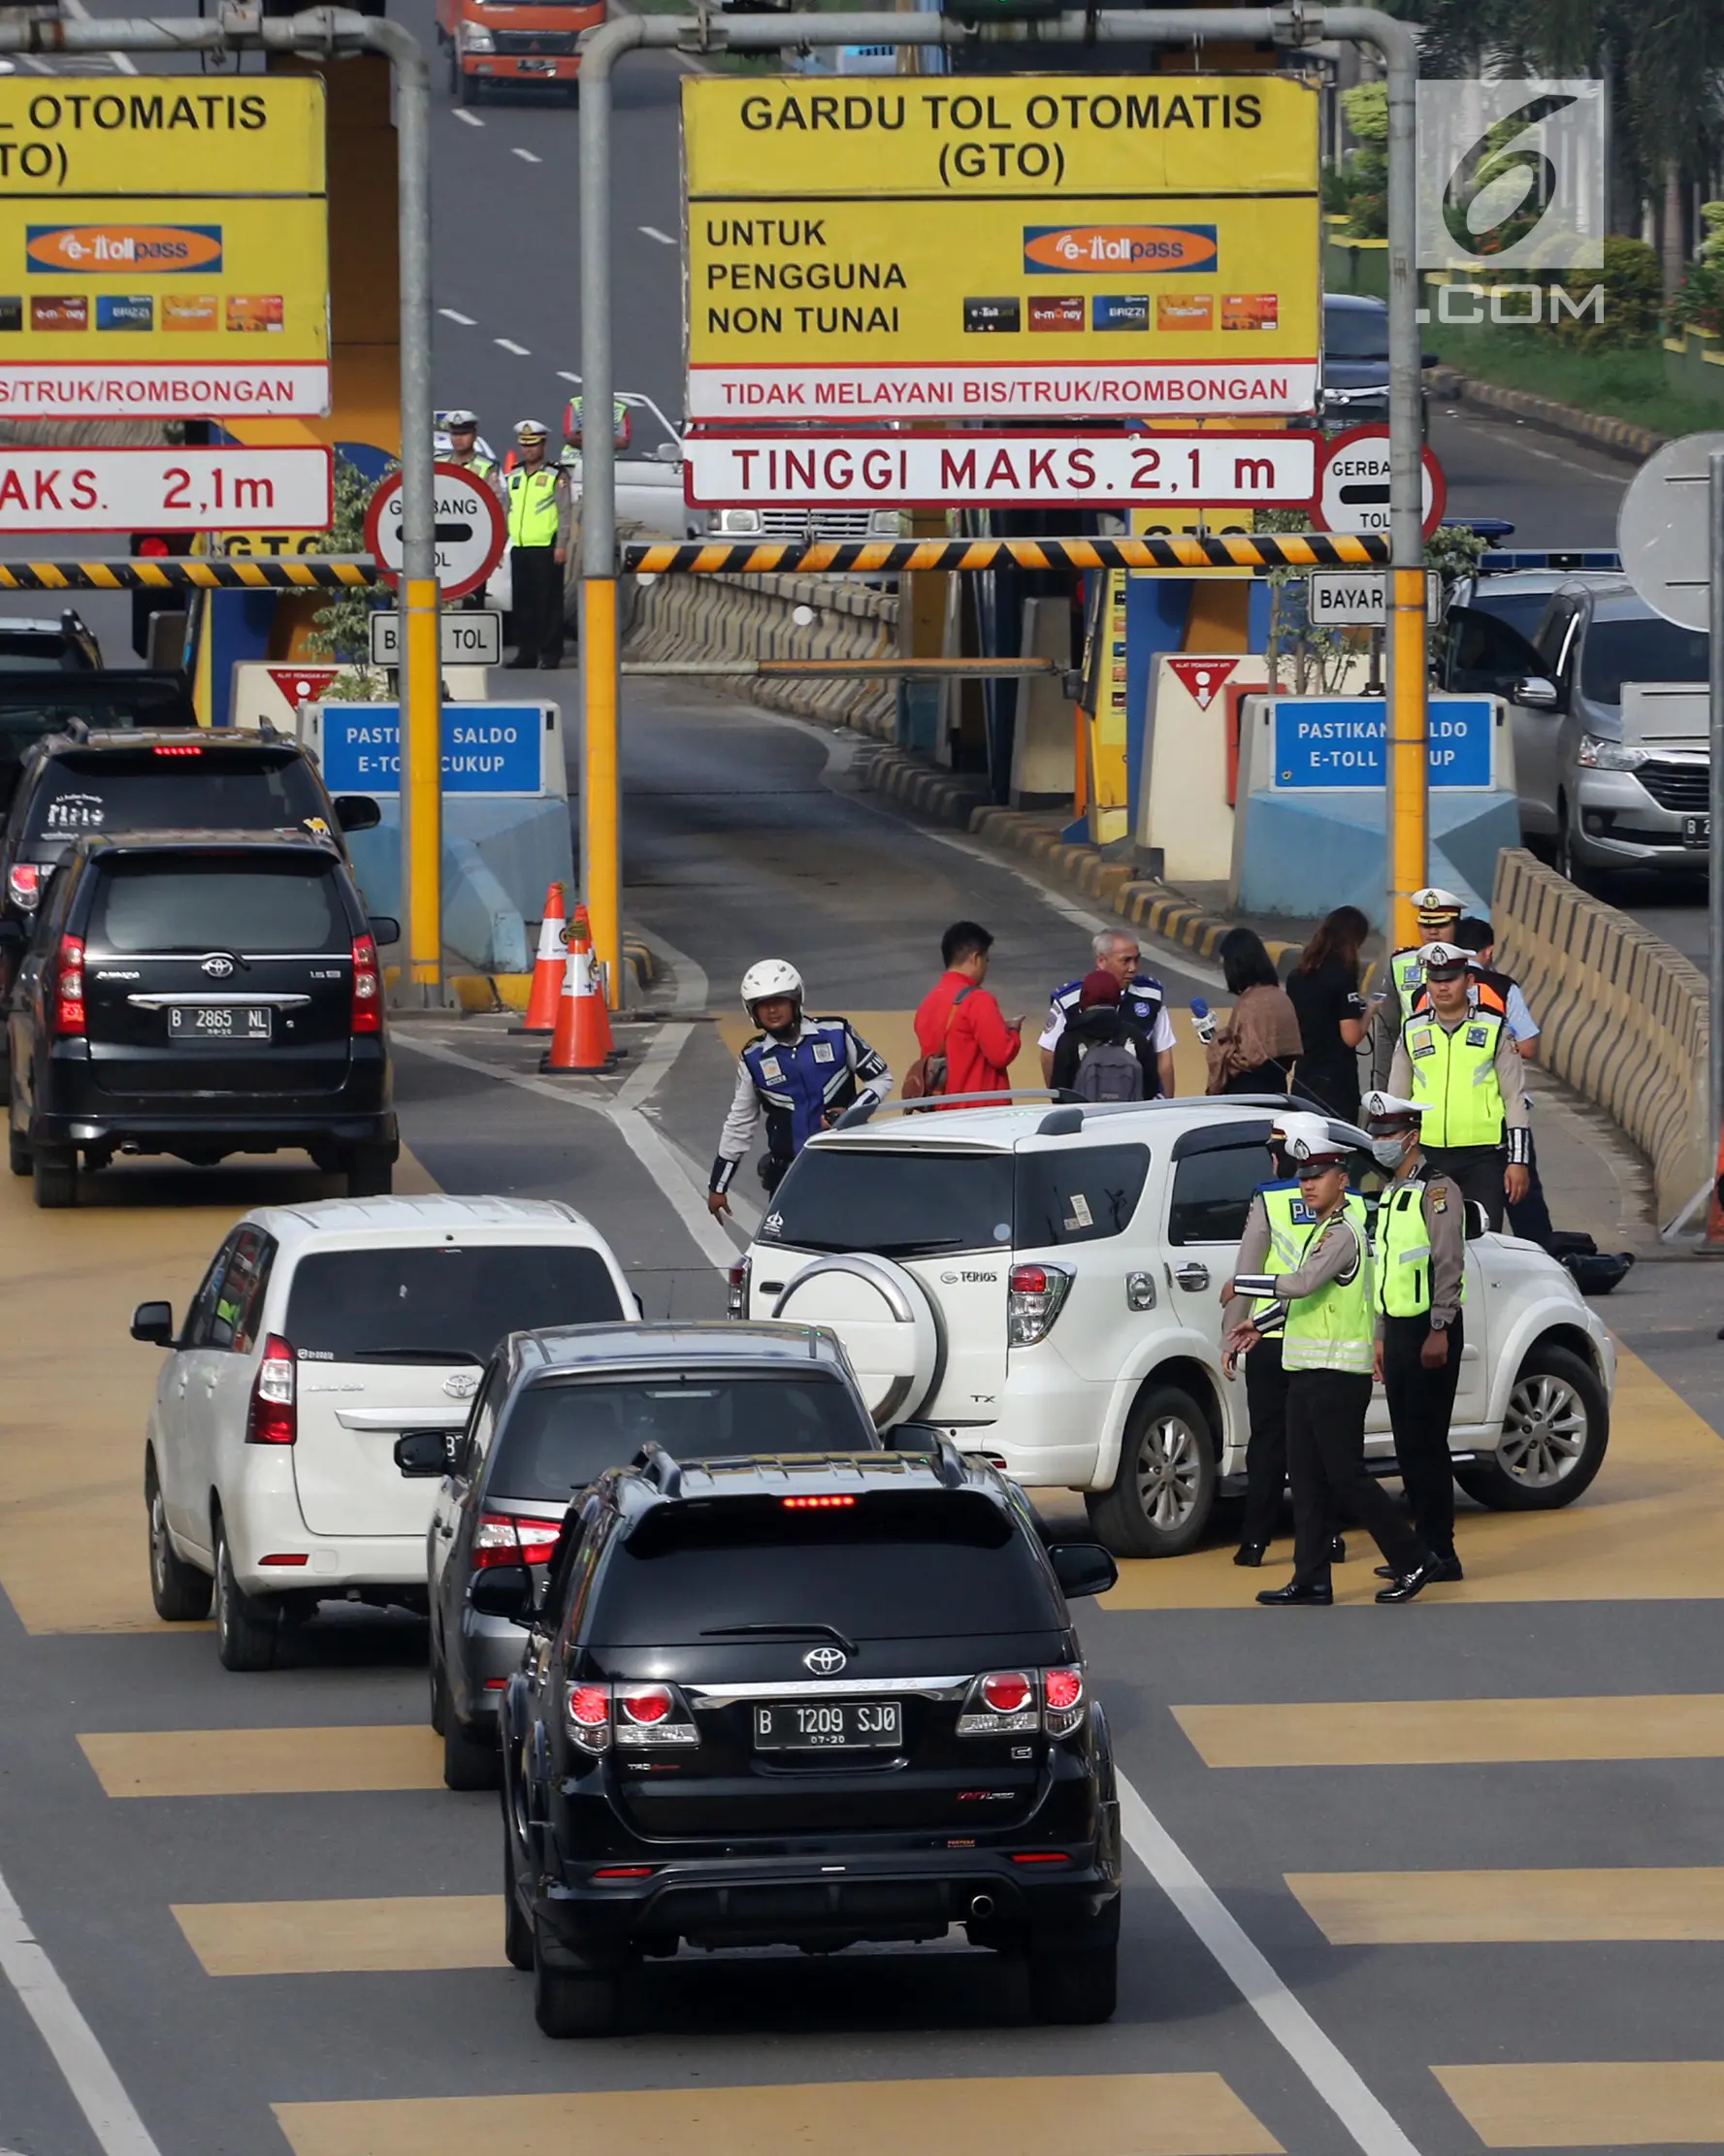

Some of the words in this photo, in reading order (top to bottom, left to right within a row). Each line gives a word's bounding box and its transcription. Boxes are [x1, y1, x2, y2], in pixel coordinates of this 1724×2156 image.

[28, 95, 267, 129] OTOMATIS
[740, 95, 905, 131] GARDU
[922, 95, 1012, 130] TOL
[1025, 93, 1262, 130] OTOMATIS
[938, 142, 1065, 187] (GTO)
[706, 220, 827, 246] UNTUK
[707, 263, 907, 290] PENGGUNA
[708, 307, 782, 334] NON
[794, 307, 899, 334] TUNAI
[721, 383, 805, 405] TIDAK
[815, 381, 953, 405] MELAYANI
[963, 378, 1287, 404] BIS/TRUK/ROMBONGAN
[732, 449, 907, 491] TINGGI
[940, 448, 1115, 491] MAKS.
[1130, 448, 1201, 494] 2,1
[1234, 458, 1276, 489] m
[1332, 461, 1391, 476] GERBA
[1360, 512, 1391, 528] TOL
[1320, 589, 1383, 609] BAYAR
[453, 629, 487, 649] TOL
[453, 727, 517, 744] SALDO
[1310, 751, 1379, 767] E-TOLL
[1687, 819, 1697, 834] B
[172, 1009, 182, 1028] B
[195, 1009, 233, 1028] 2865
[248, 1010, 267, 1028] NL
[960, 1271, 998, 1283] TERIOS
[970, 1394, 996, 1403] TX
[759, 1710, 772, 1735] B
[797, 1708, 844, 1734] 1209
[811, 1735, 846, 1744] 07-20
